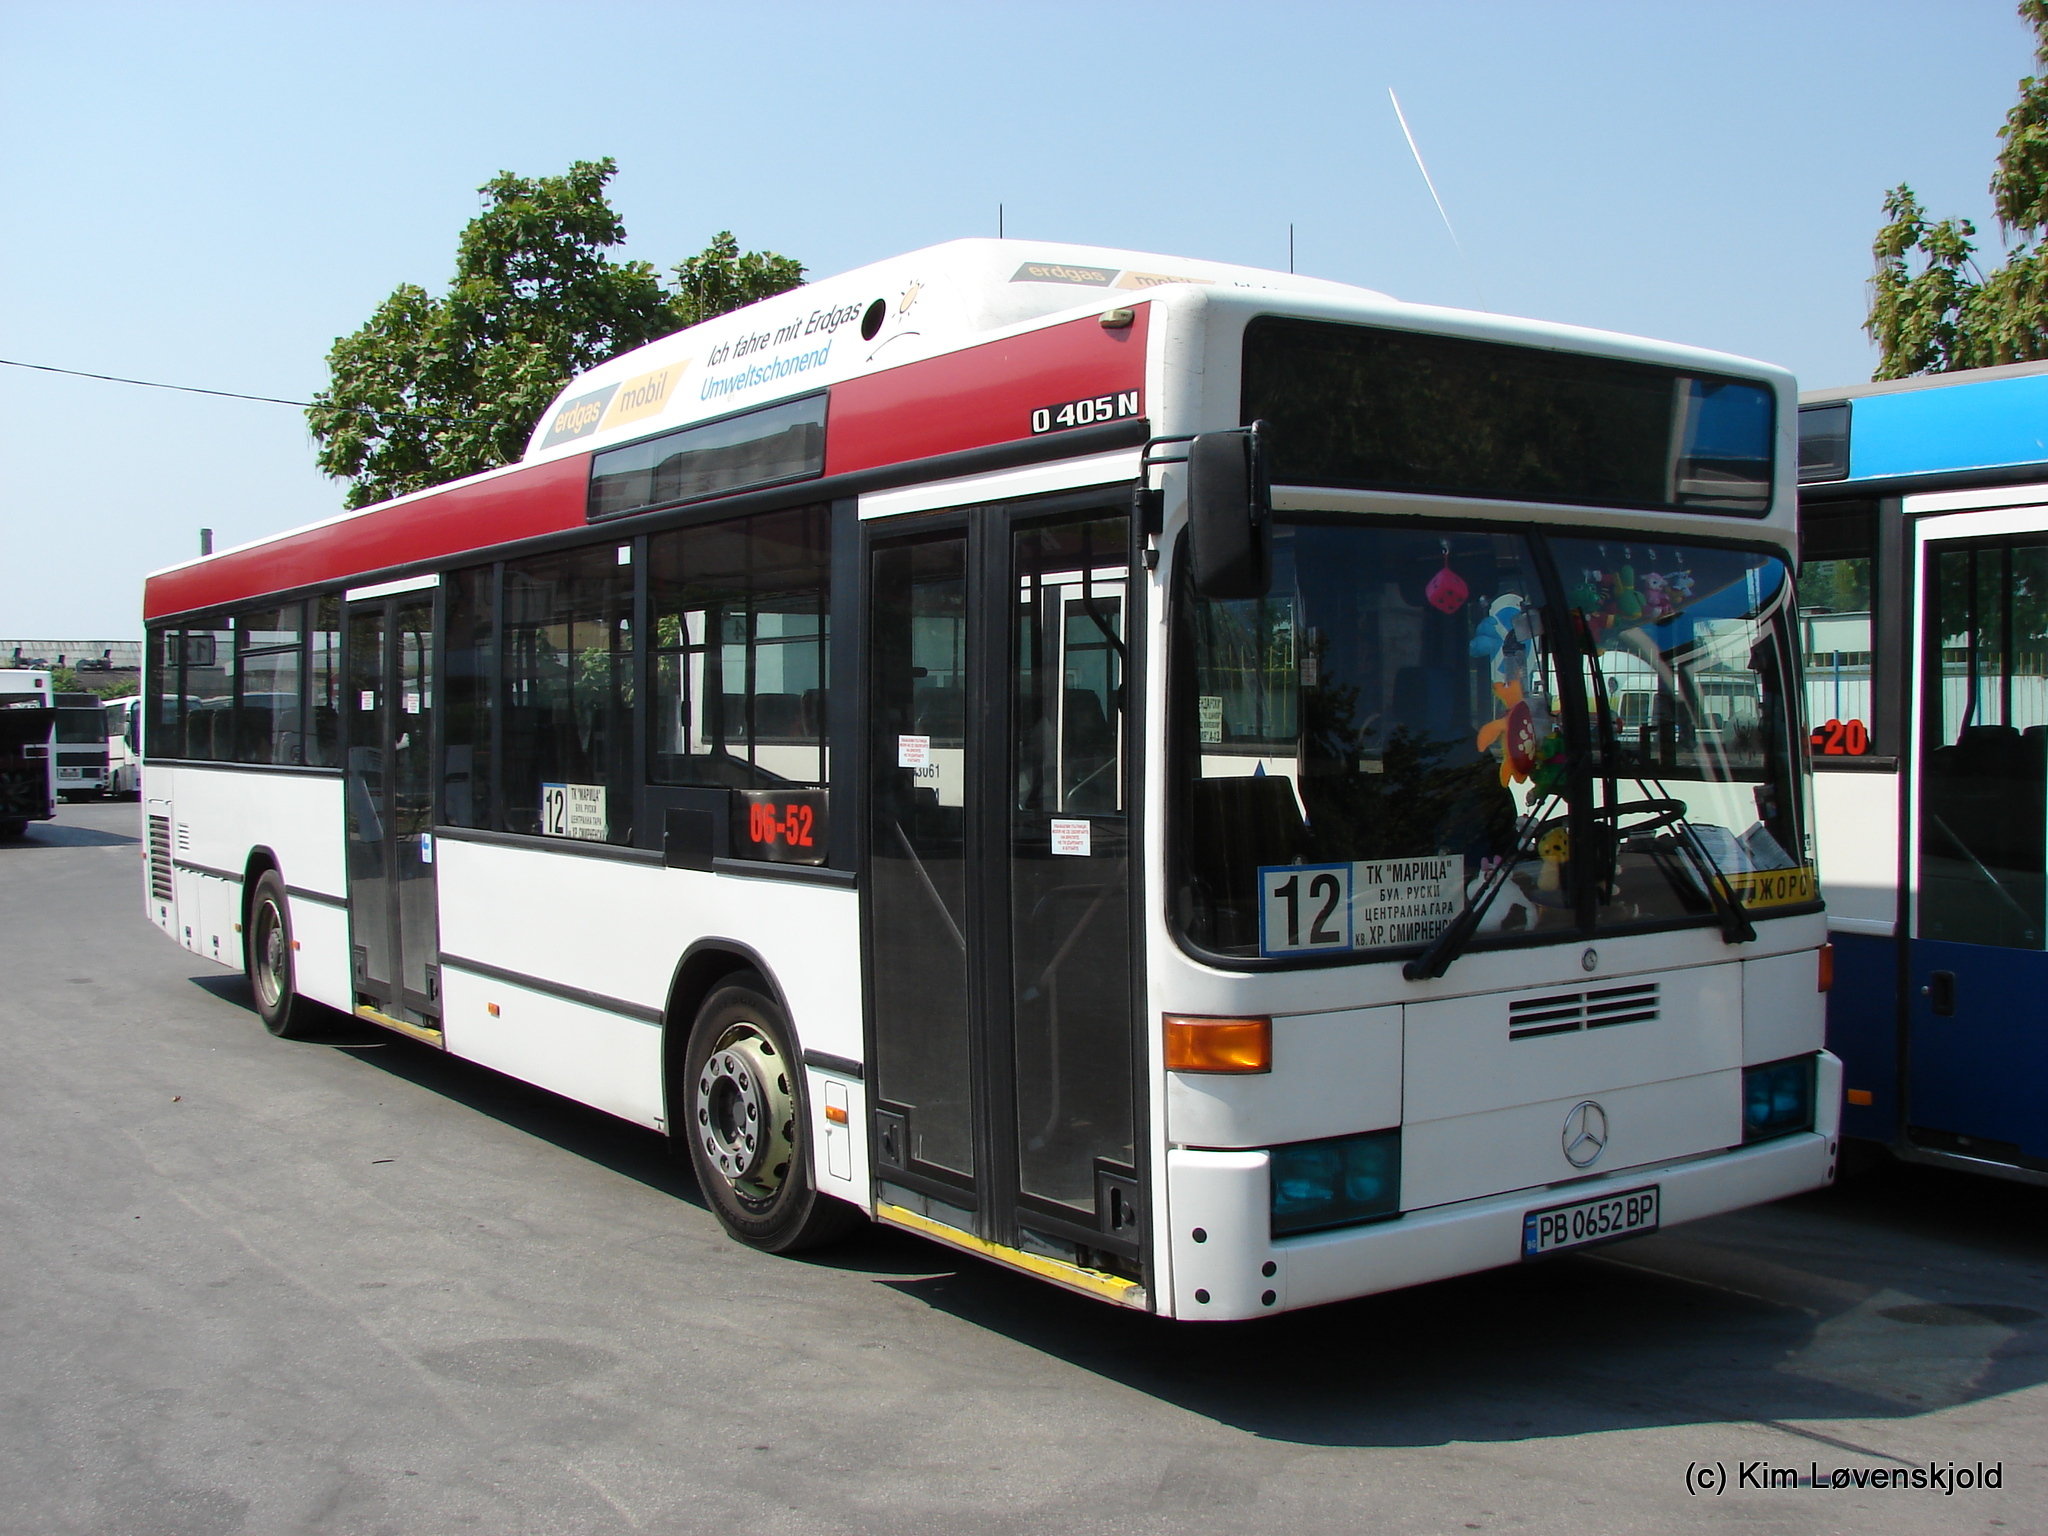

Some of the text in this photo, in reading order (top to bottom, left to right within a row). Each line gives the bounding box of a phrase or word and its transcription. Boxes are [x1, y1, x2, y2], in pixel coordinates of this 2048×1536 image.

[1028, 264, 1106, 282] erdgas
[707, 302, 863, 368] Ich fahre mit Erdgas
[700, 338, 833, 401] Umweltschonend
[619, 371, 669, 413] mobil
[1056, 396, 1113, 427] 405
[1118, 390, 1138, 417] N
[554, 400, 602, 434] erdgas
[1803, 718, 1867, 756] -20
[545, 789, 564, 834] 12
[750, 803, 813, 847] 06-52
[1366, 860, 1452, 885] ТК "МАРИЦА"
[1273, 873, 1341, 946] 12
[1365, 901, 1454, 923] ЦЕНТРАЛНА ГАРА
[1379, 884, 1441, 902] БУЛ. РУСКИ
[1369, 925, 1386, 945] ХР.
[1389, 917, 1453, 944] СМИРНЕНС
[1573, 1201, 1623, 1240] 0652
